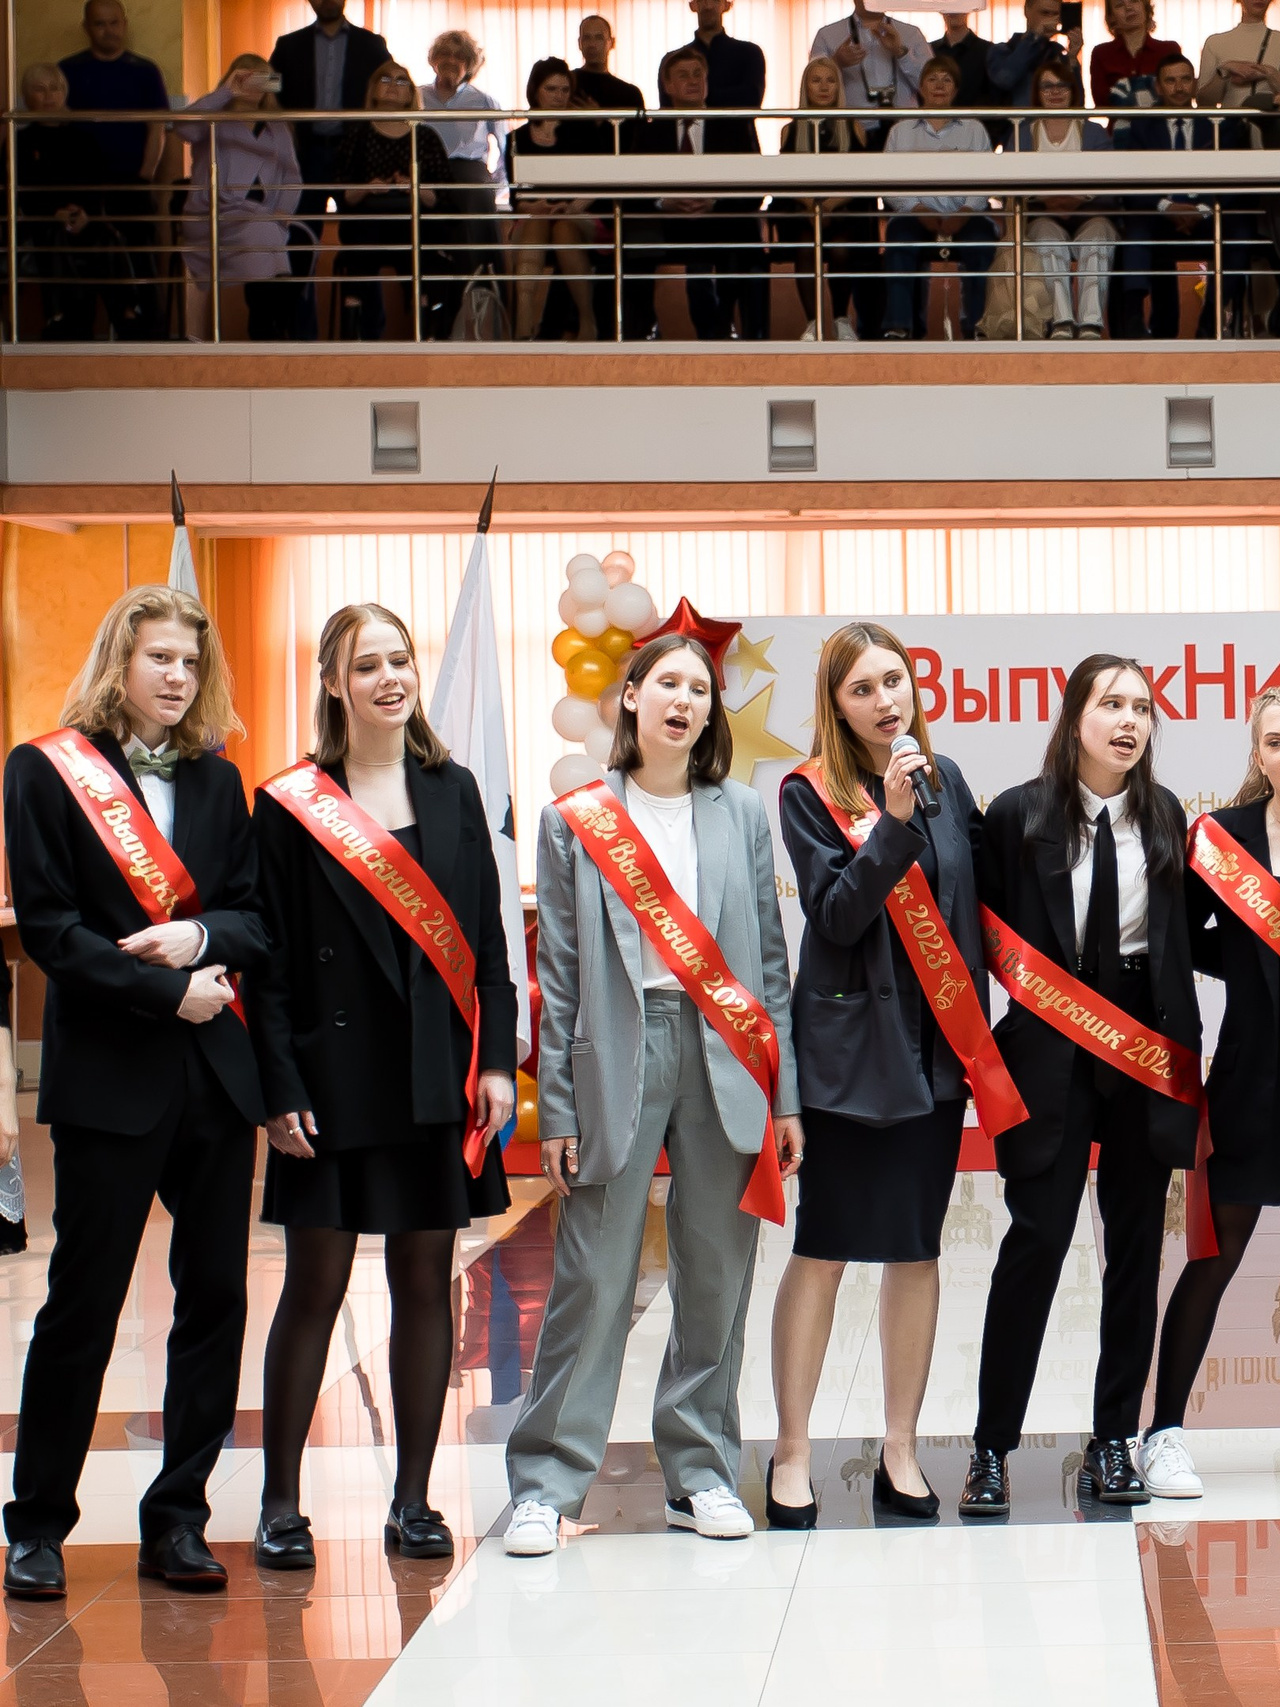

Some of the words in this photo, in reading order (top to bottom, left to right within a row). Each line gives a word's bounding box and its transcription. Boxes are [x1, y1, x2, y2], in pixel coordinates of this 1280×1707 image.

[307, 793, 427, 917] Выпускник
[420, 910, 466, 973] 2023
[607, 836, 709, 976] Выпускник
[700, 971, 757, 1032] 2023
[905, 903, 951, 970] 2023
[1000, 947, 1126, 1050] Выпускник
